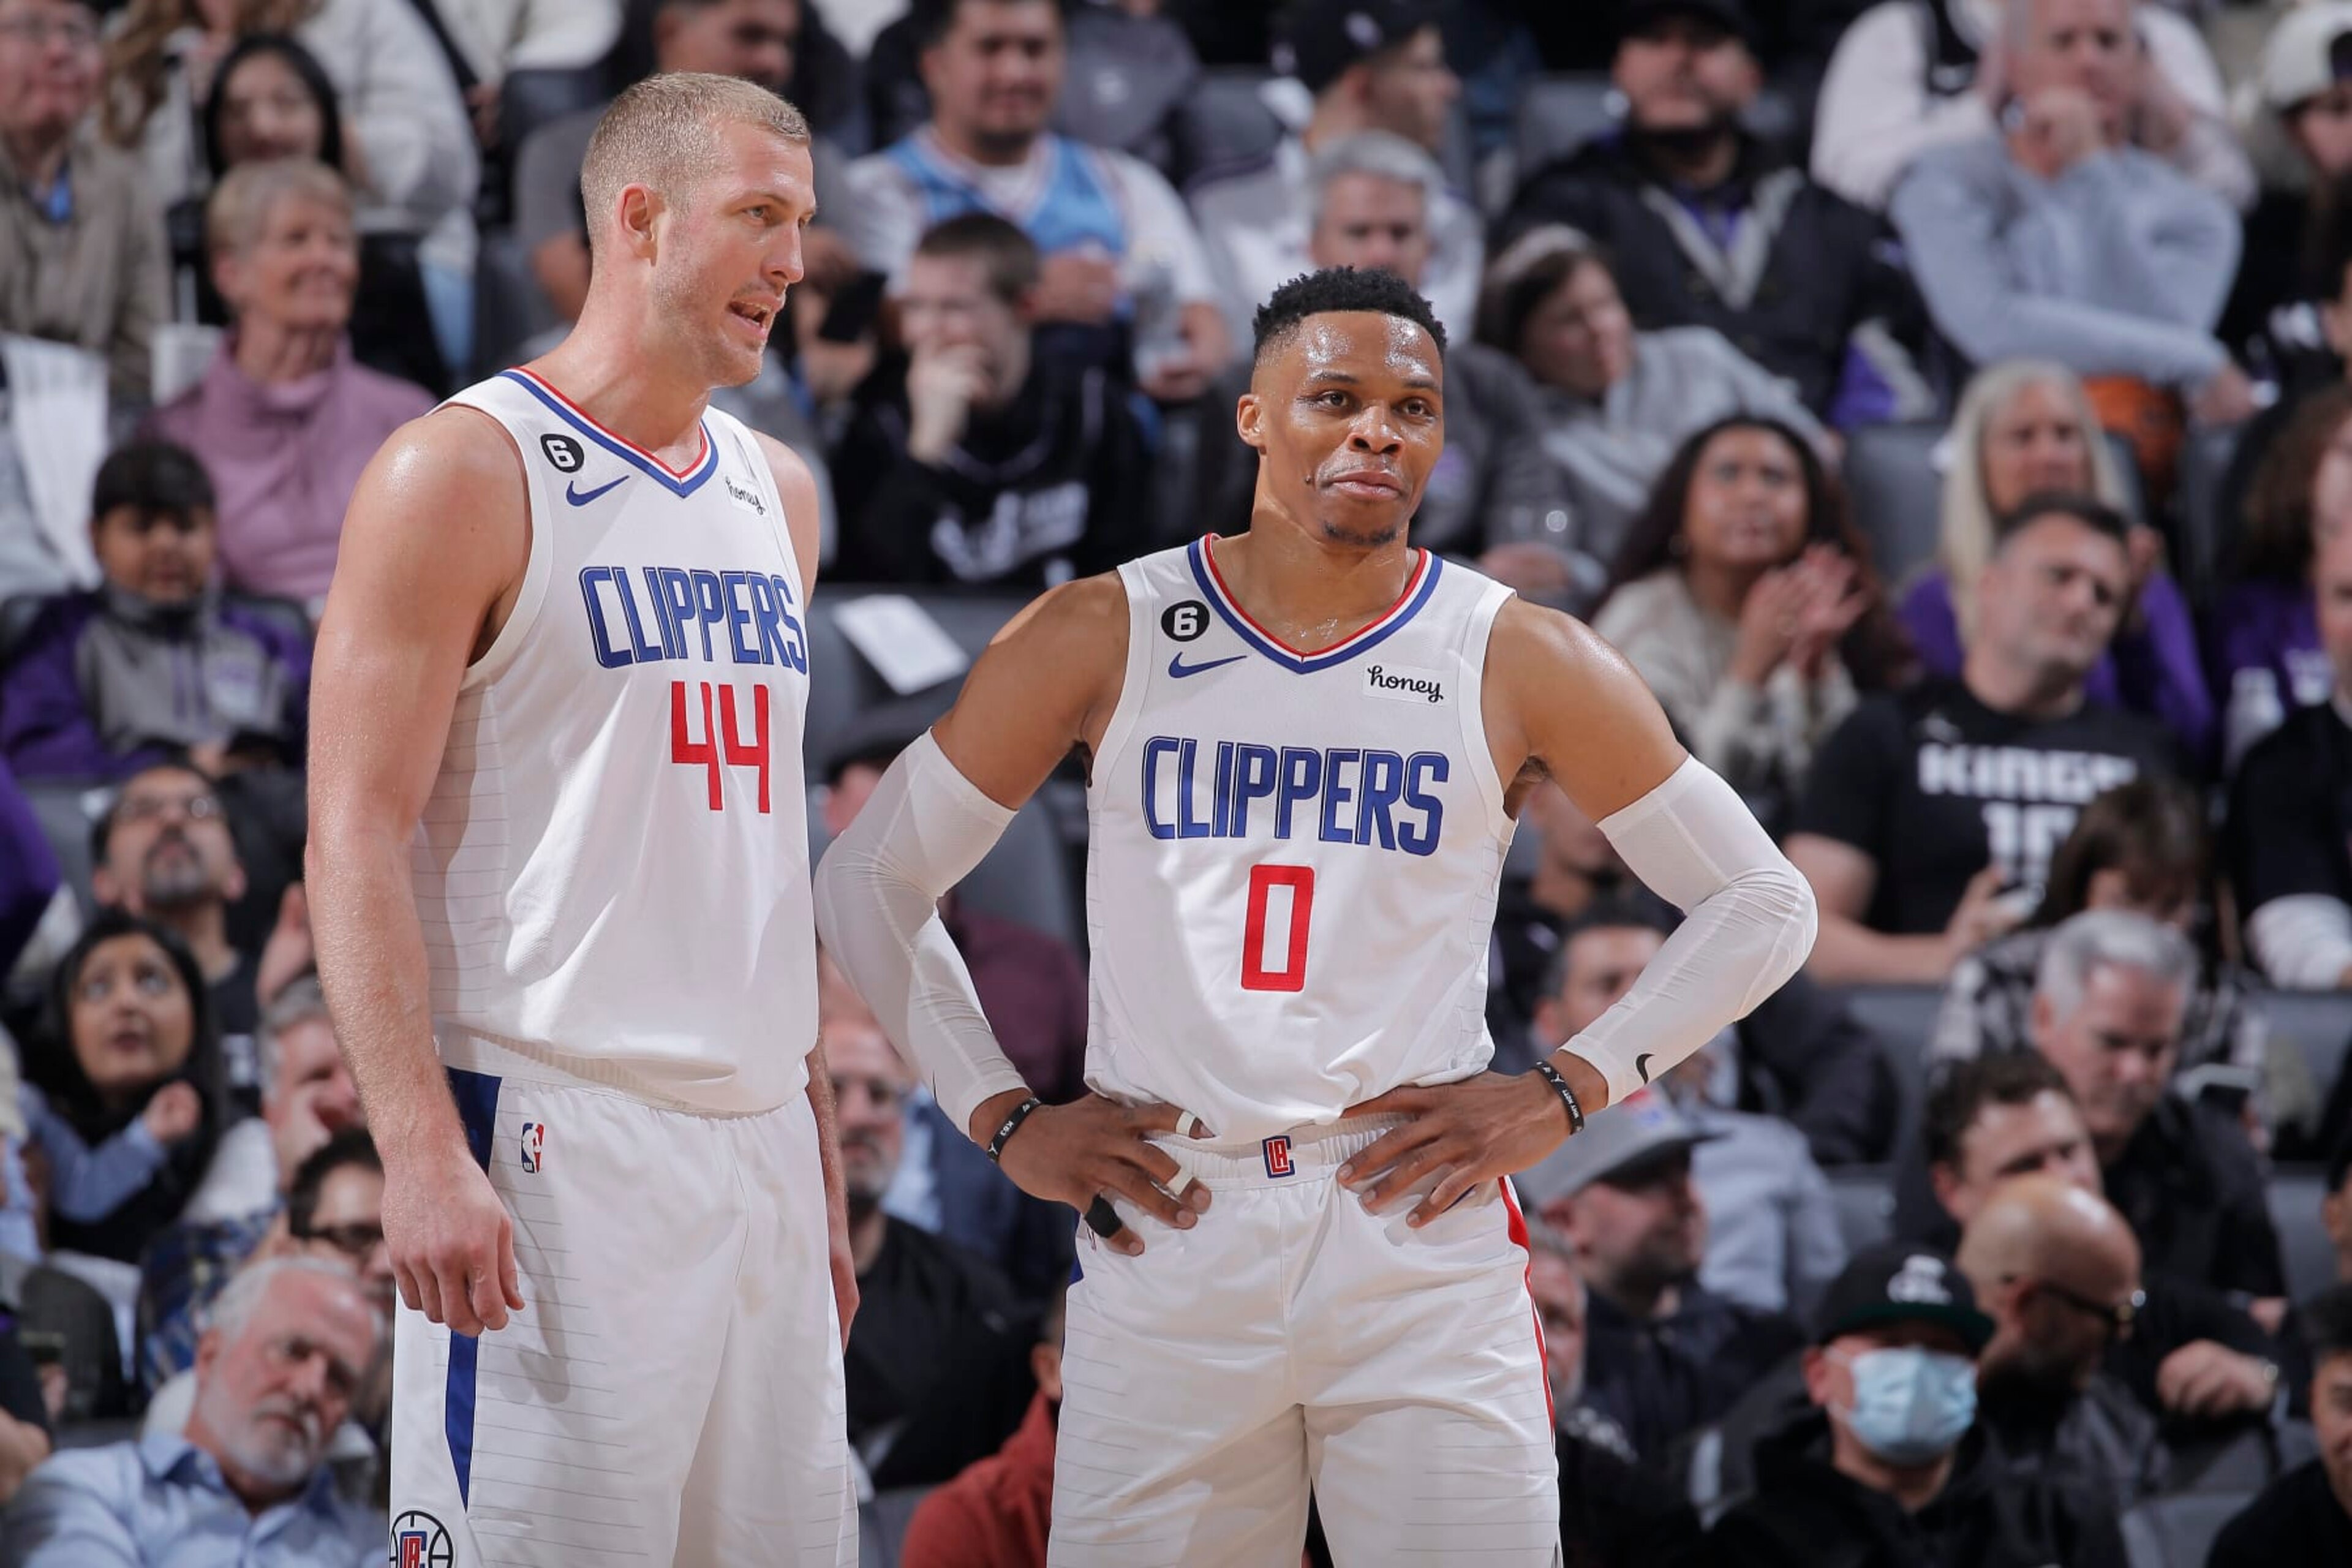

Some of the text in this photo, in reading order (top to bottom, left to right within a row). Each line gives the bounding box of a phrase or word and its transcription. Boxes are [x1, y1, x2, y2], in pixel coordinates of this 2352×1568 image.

[546, 439, 575, 469] 6
[578, 566, 807, 676] CLIPPERS
[1172, 606, 1198, 637] 6
[1367, 665, 1444, 704] honey
[671, 680, 771, 814] 44
[1141, 736, 1450, 857] CLIPPERS
[1240, 864, 1315, 992] 0
